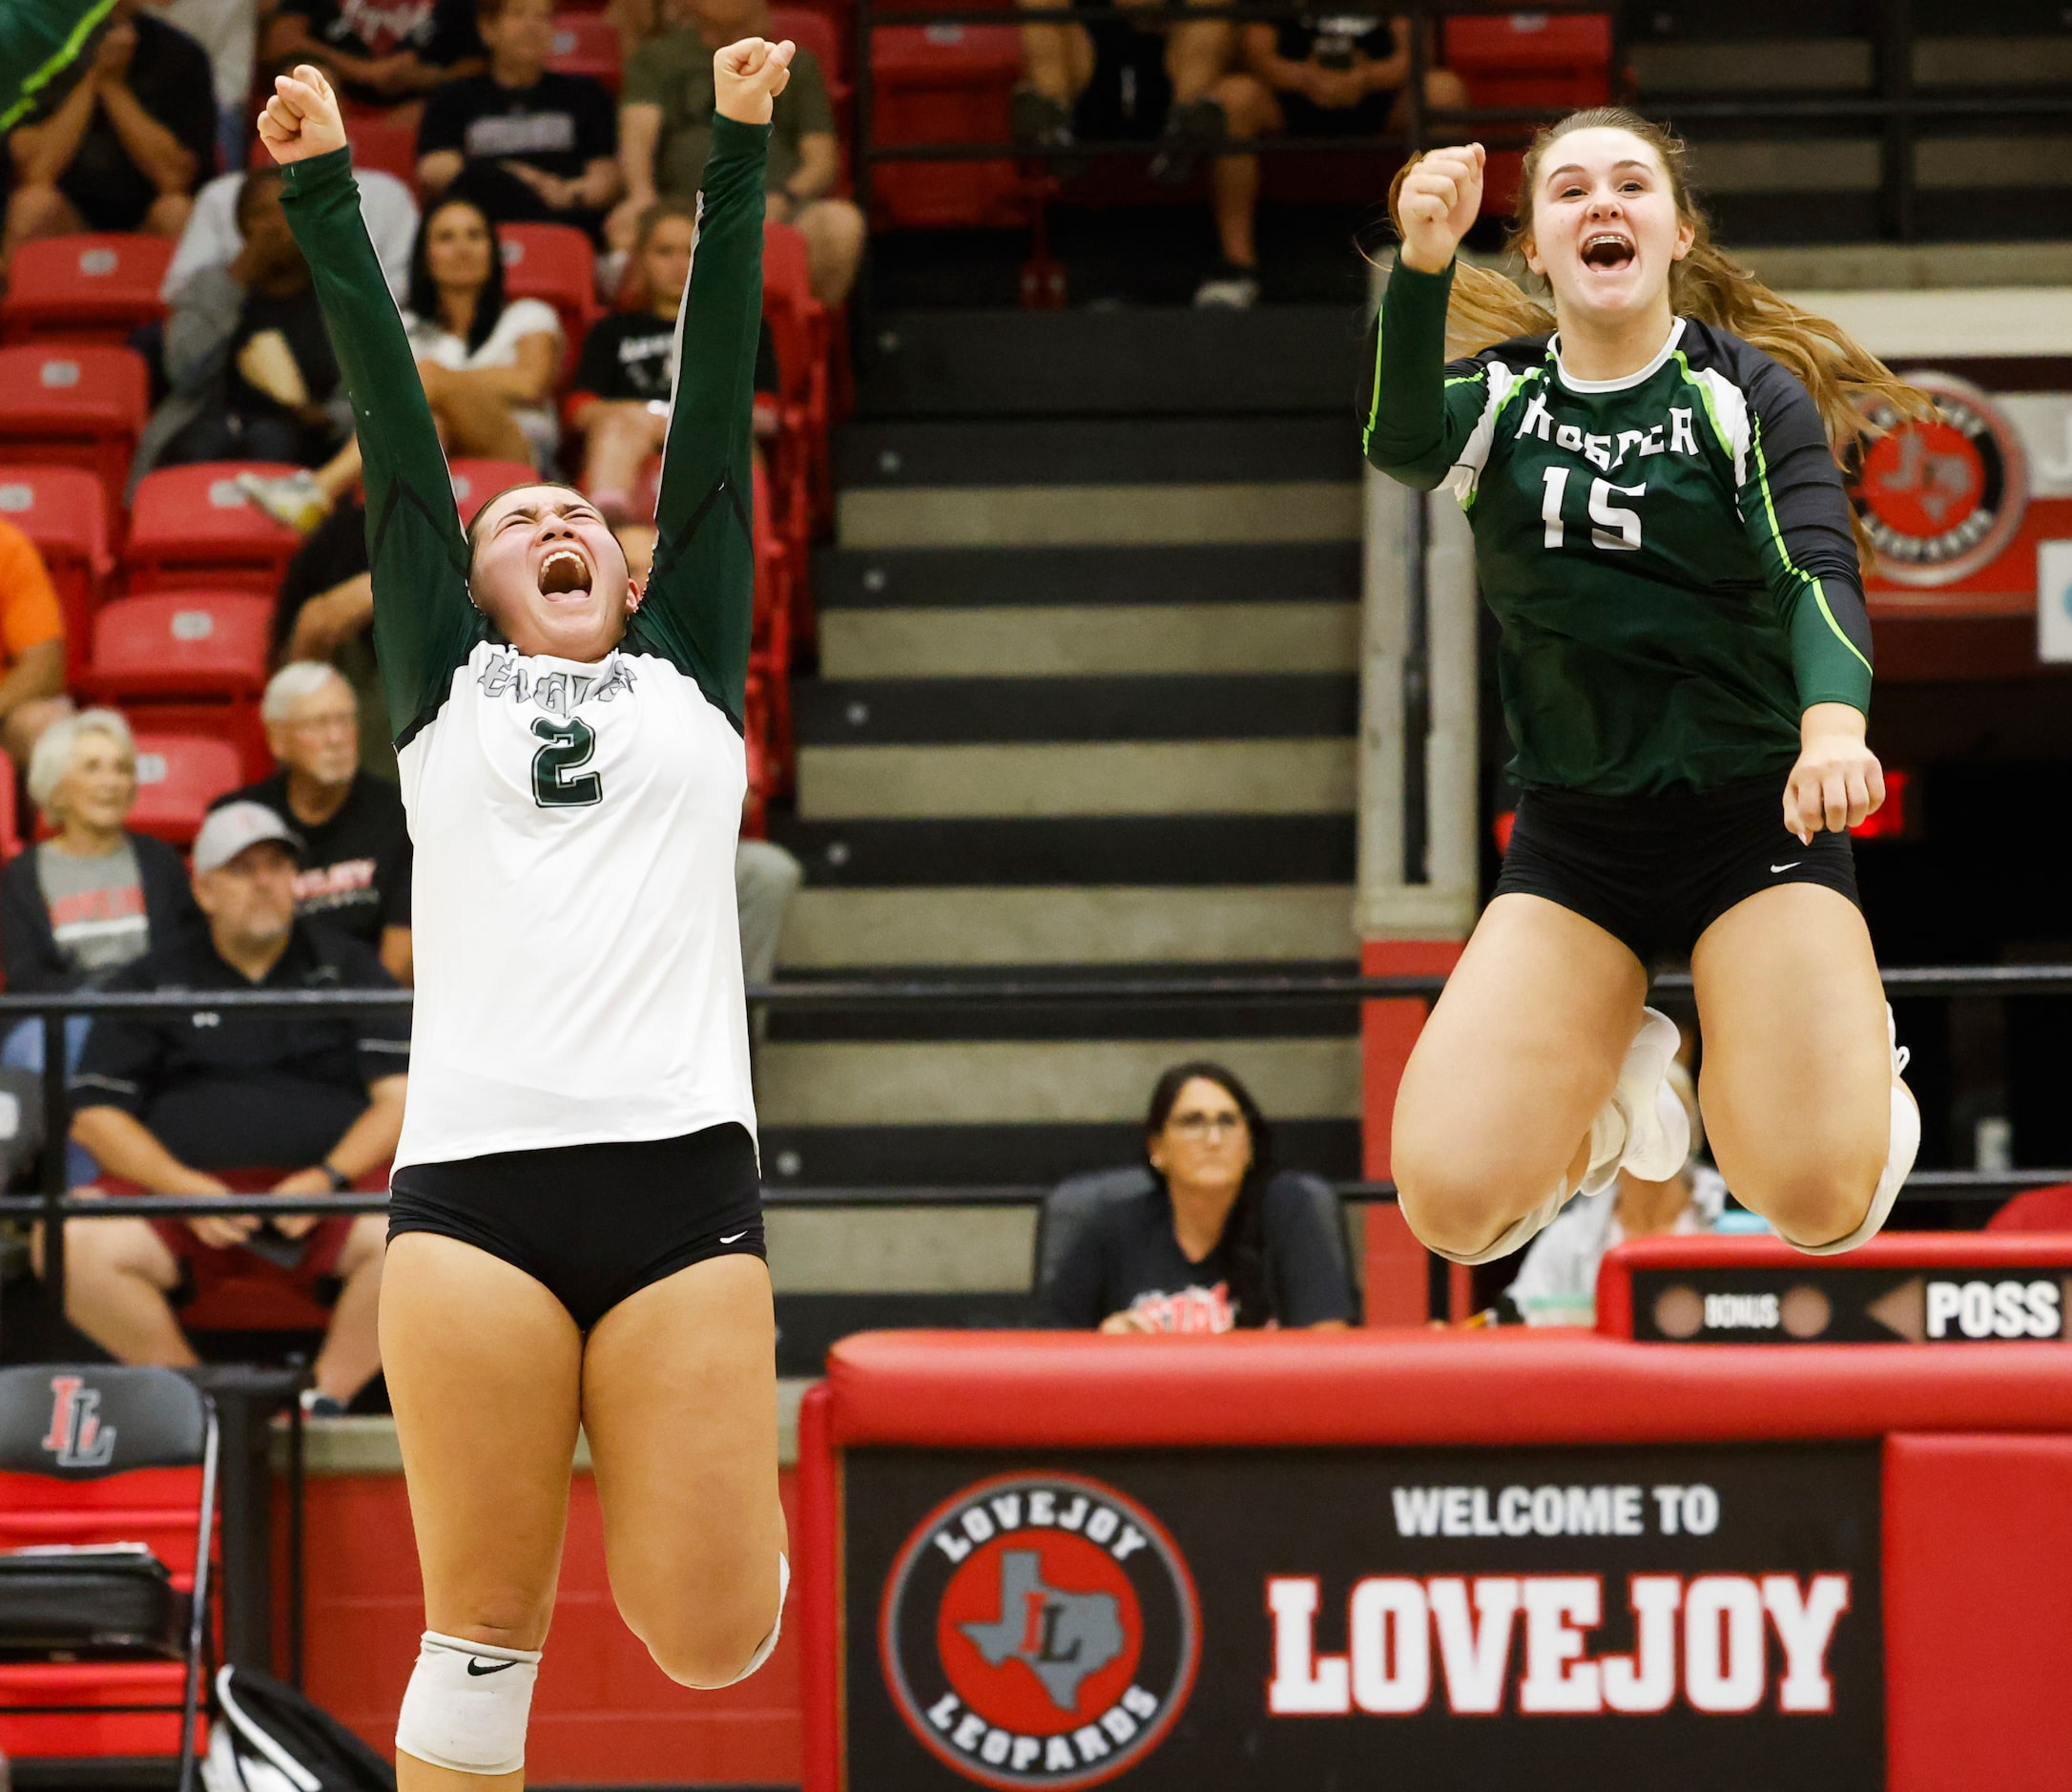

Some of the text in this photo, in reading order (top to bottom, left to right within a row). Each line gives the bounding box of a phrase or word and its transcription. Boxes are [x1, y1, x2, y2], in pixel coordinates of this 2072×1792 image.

[1542, 465, 1647, 551] 15
[530, 716, 603, 808] 2
[1704, 1293, 1779, 1329] BONUS
[1925, 1280, 2062, 1338] POSS
[933, 1490, 1148, 1565] LOVEJOY
[1392, 1485, 1720, 1537] WELCOME TO
[1264, 1573, 1850, 1715] LOVEJOY
[926, 1684, 1159, 1773] LEOPARDS
